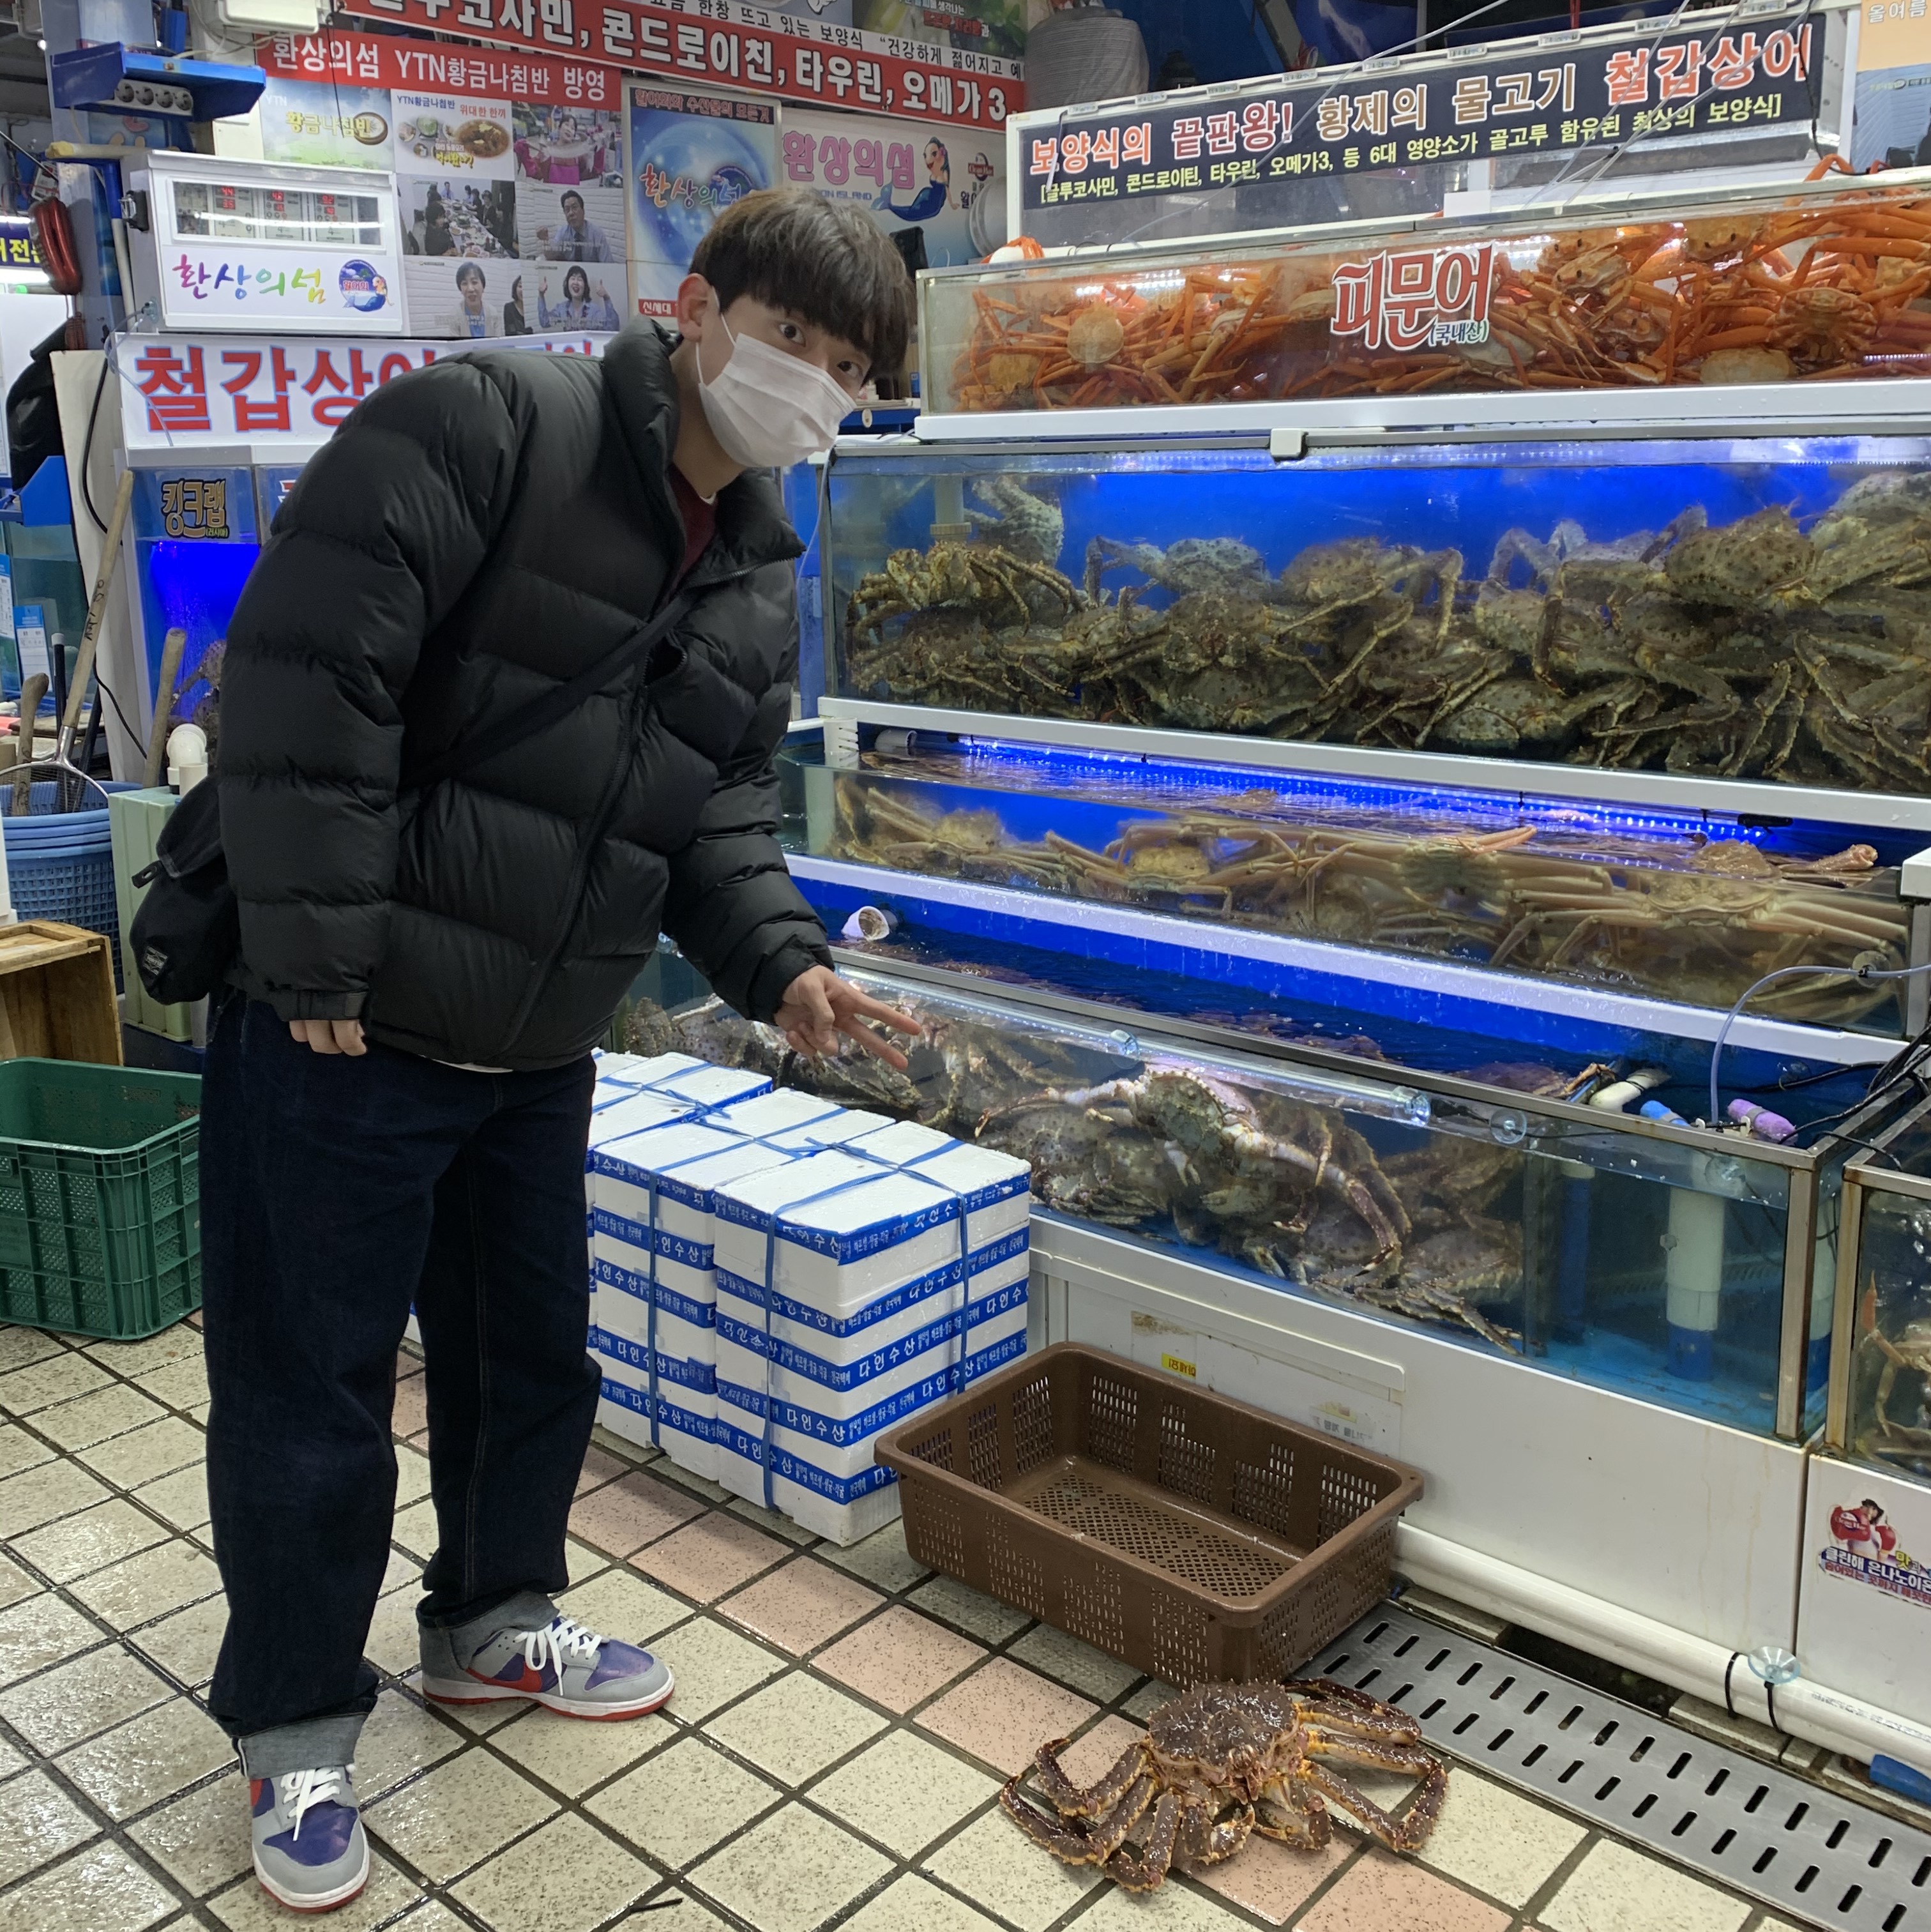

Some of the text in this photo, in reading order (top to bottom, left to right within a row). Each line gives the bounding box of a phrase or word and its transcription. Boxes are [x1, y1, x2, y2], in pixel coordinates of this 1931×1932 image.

[602, 6, 785, 86] 콘드로이친,
[796, 48, 892, 105] 타우린,
[699, 0, 729, 20] 한창
[741, 7, 771, 27] 뜨고
[780, 15, 810, 38] 있는
[821, 25, 862, 50] 보양식
[951, 50, 1003, 75] 젊어지고
[273, 31, 605, 102] 환상의섬 YTN황금나침반 방영
[397, 95, 455, 109] YTN황금나침반
[490, 107, 506, 119] 한끼
[1029, 24, 1813, 175] 보양식의 끝판왕! 황제의 물고기 철갑상어
[783, 130, 915, 190] 환상의섬
[1126, 169, 1202, 194] 콘드로이틴,
[1211, 158, 1261, 184] 타우린,
[1269, 150, 1333, 177] 오메가3,
[1343, 148, 1361, 169] 등
[1369, 141, 1397, 164] 6대
[1407, 132, 1478, 160] 영양소가
[1489, 124, 1549, 150] 골고루
[1560, 114, 1620, 143] 함유된
[1633, 104, 1695, 132] 최상의
[1709, 93, 1782, 123] 보양식]
[836, 190, 872, 201] ISLAND
[172, 254, 326, 304] 환상의섬
[1331, 240, 1496, 351] 피문어
[642, 301, 671, 314] 신세대
[1429, 320, 1489, 347] (국내산)
[162, 480, 226, 538] 킹크랩
[859, 1338, 915, 1378] 다인수산
[921, 1362, 974, 1398] 다인수산
[785, 1408, 846, 1443] 다인수산
[1826, 1547, 1865, 1571] 클린해
[1895, 1550, 1921, 1575] 맛과
